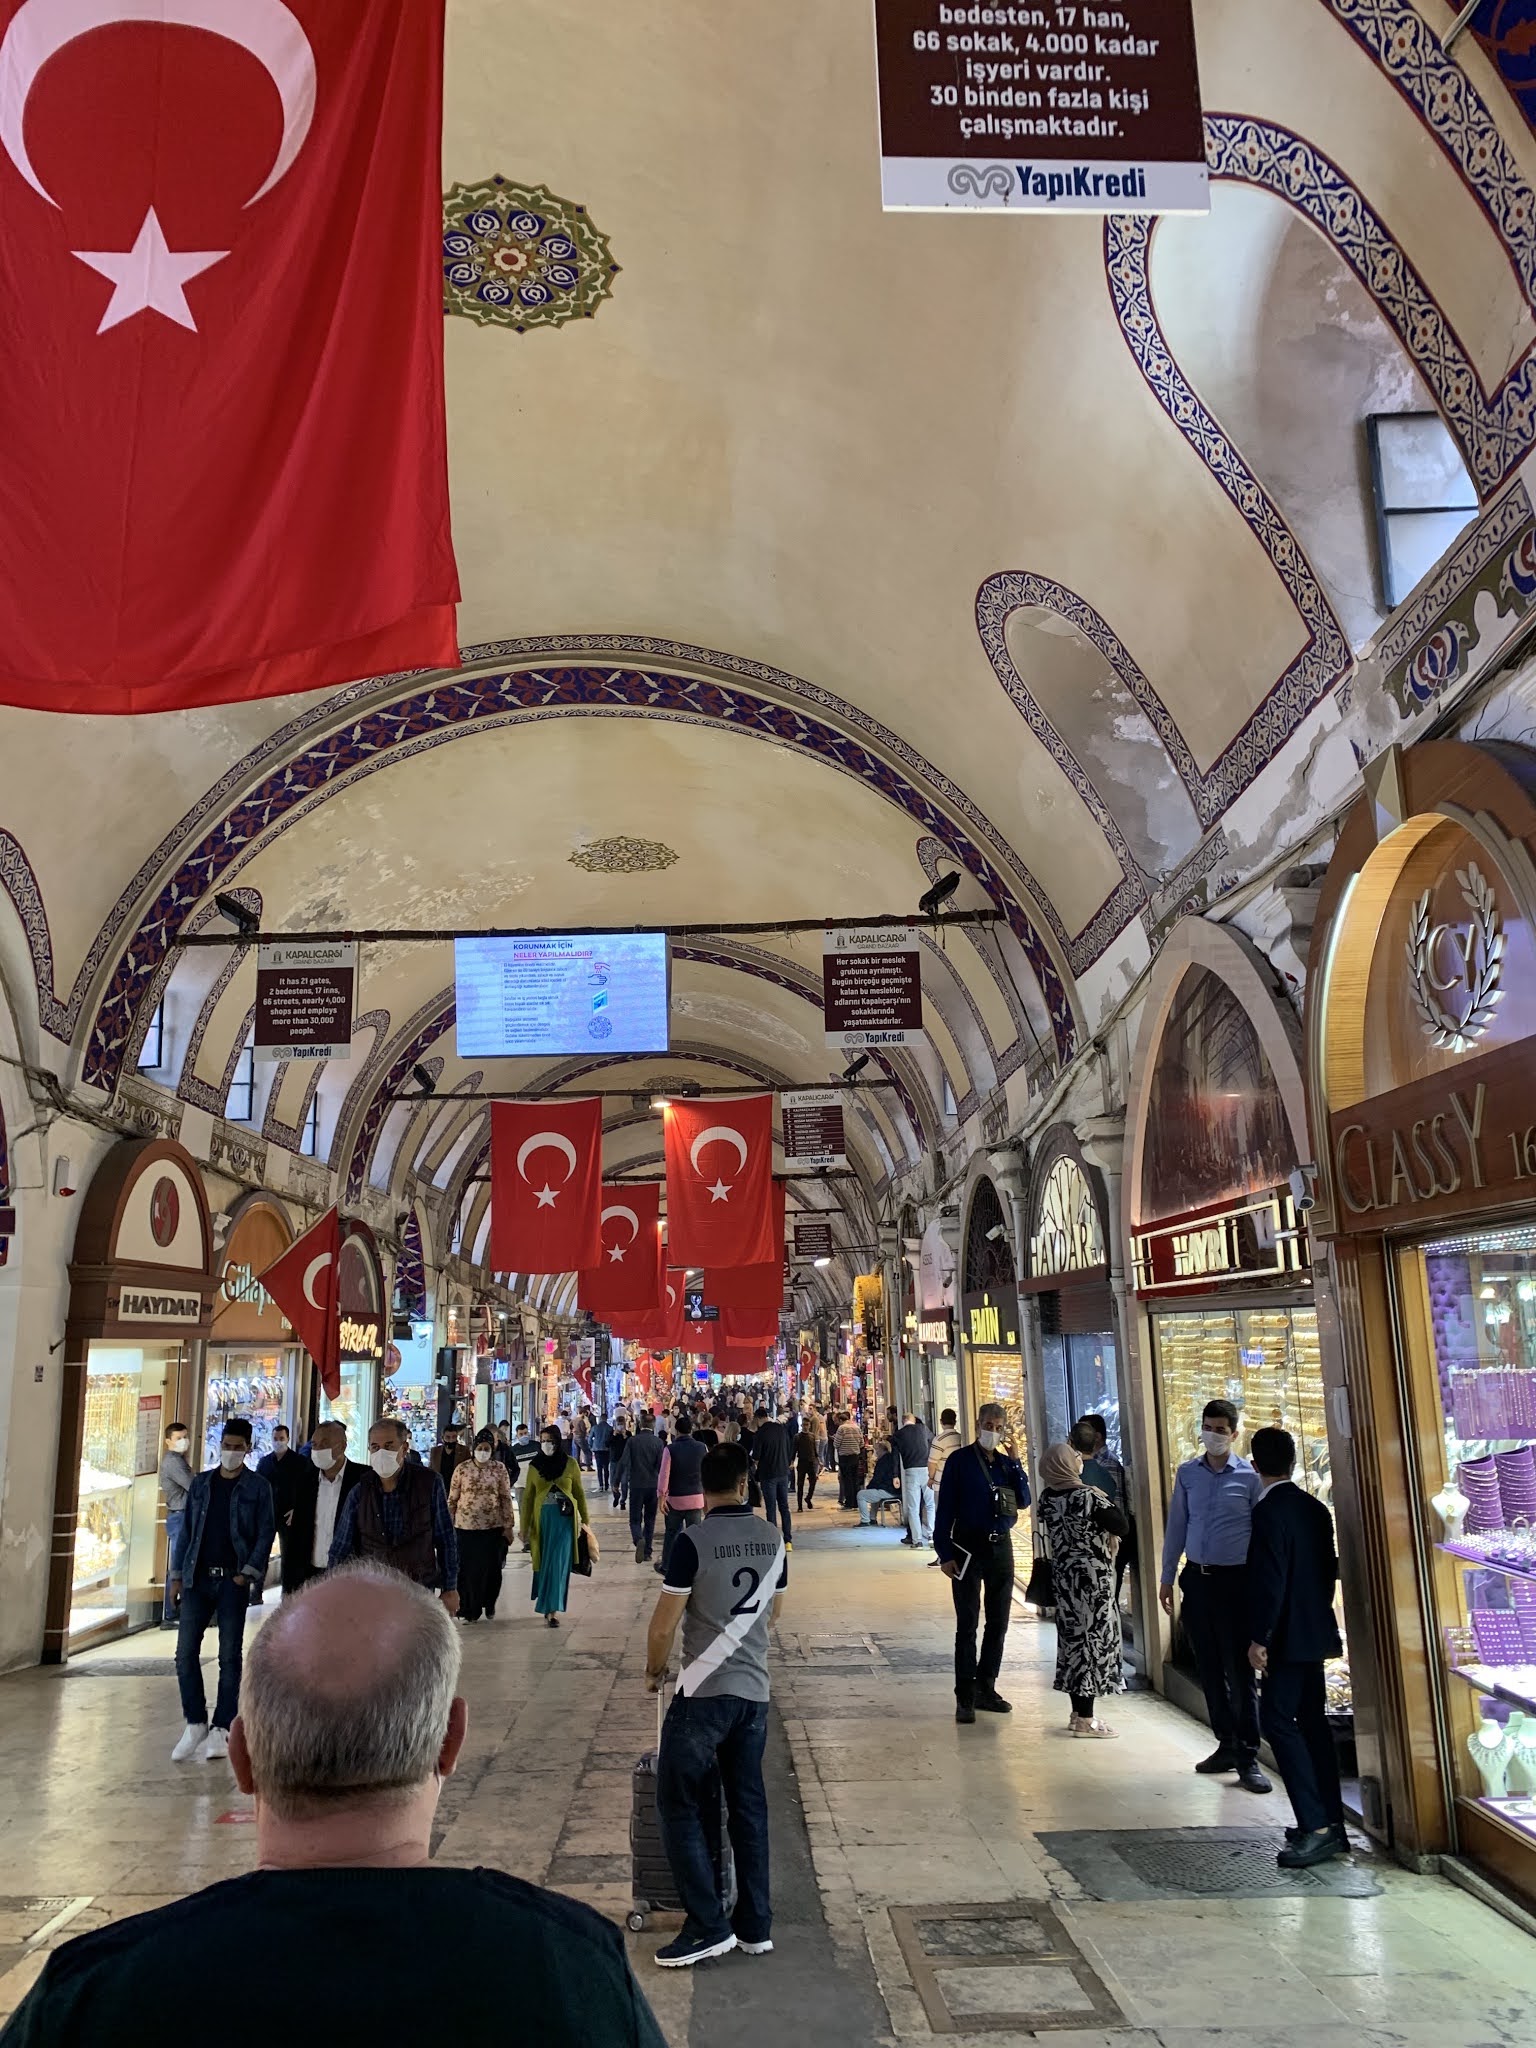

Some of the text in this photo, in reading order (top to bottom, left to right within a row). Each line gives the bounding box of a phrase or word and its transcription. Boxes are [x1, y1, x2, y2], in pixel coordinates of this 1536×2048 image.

[940, 5, 1130, 30] bedesten, 17 han,
[913, 30, 1158, 56] 66 sokak, 4.000 kadar
[966, 58, 1110, 84] işyeri vardır.
[930, 86, 1149, 114] 30 binden fazla kişi
[960, 114, 1124, 139] çalışmaktadır.
[1427, 923, 1475, 993] CY
[832, 976, 912, 987] Bugün birçoğu geçmişte
[840, 968, 867, 976] grubuna
[302, 997, 324, 1006] nearly
[308, 1007, 337, 1016] employs
[1337, 1083, 1486, 1214] CLASSY
[1031, 1222, 1094, 1278] HAYDAR
[122, 1294, 198, 1316] HAYDAR
[715, 1544, 740, 1559] LOUIS
[730, 1567, 760, 1615] 2
